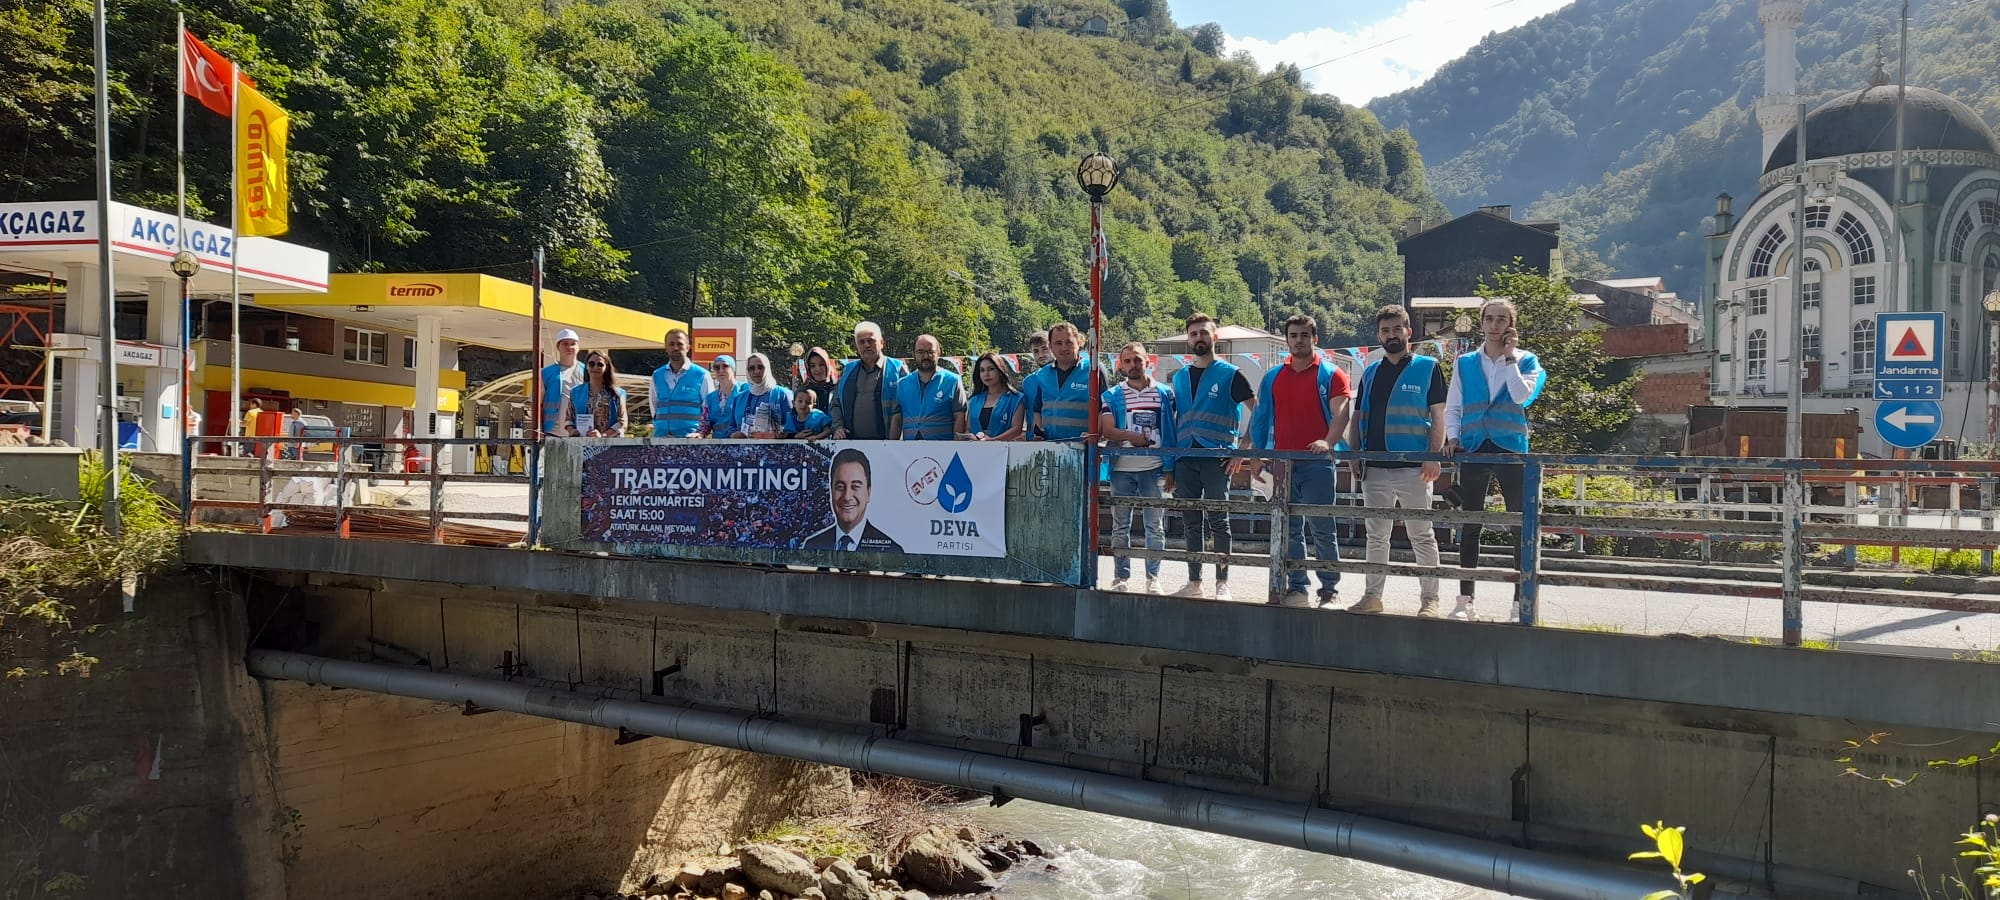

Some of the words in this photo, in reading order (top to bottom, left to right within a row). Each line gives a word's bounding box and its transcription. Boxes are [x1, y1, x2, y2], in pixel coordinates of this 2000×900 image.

[247, 122, 267, 218] termo
[390, 285, 436, 297] termo
[1880, 366, 1939, 375] Jandarma
[611, 467, 712, 490] TRABZON
[716, 461, 807, 491] MİTİNGİ
[911, 466, 939, 496] EVET
[610, 495, 615, 506] 1
[616, 494, 641, 506] EKİM
[643, 495, 705, 508] CUMARTESİ
[610, 509, 636, 520] SAAT
[639, 509, 665, 521] 15:00
[609, 522, 640, 532] ATATÜRK
[664, 525, 696, 534] MEYDAN
[930, 519, 980, 537] DEVA
